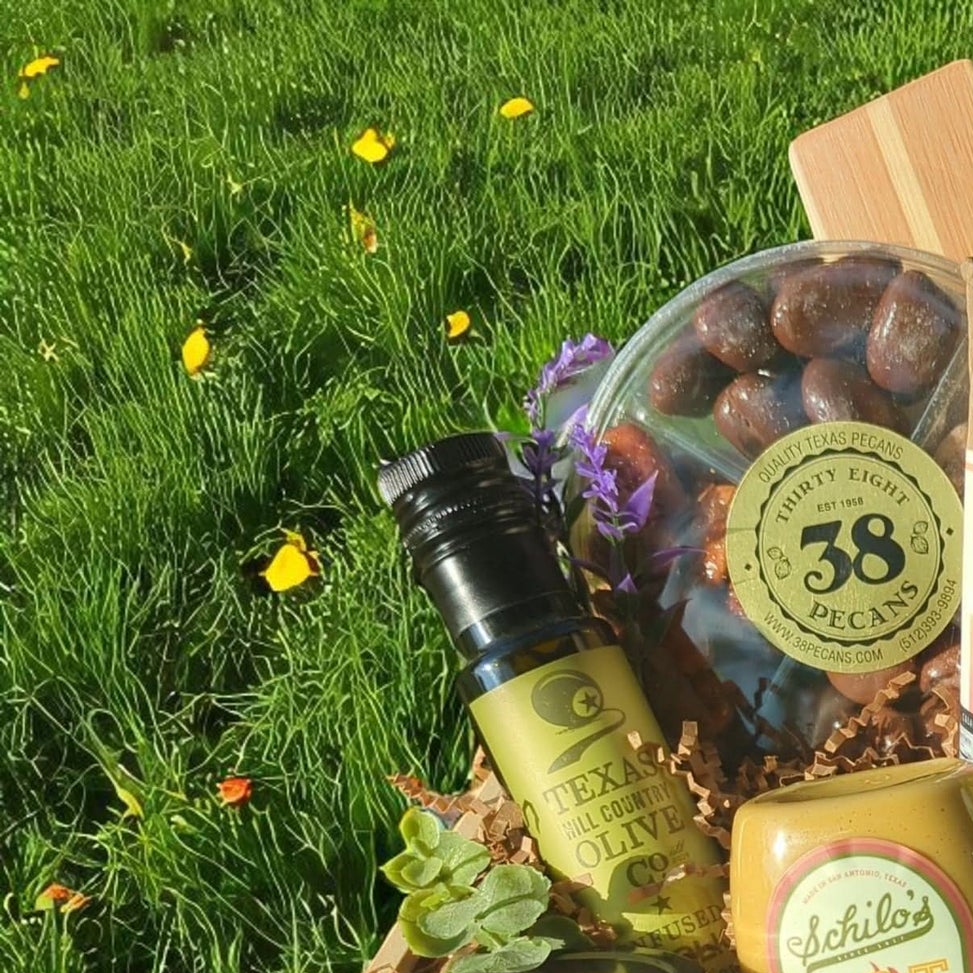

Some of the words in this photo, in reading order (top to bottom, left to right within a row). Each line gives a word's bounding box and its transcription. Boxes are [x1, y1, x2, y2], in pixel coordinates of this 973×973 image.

[758, 443, 801, 483] QUALITY
[805, 431, 847, 452] TEXAS
[851, 432, 904, 460] PECANS
[775, 468, 837, 525] THIRTY
[848, 467, 910, 506] EIGHT
[817, 501, 837, 513] EST
[800, 513, 906, 595] 38
[763, 612, 884, 664] WWW.38PECANS.COM
[899, 579, 958, 653] (512)393-9894
[809, 580, 919, 630] PECANS
[543, 749, 659, 816] TEXAS
[561, 812, 599, 841] HILL
[600, 781, 671, 824] COUNTRY
[575, 806, 686, 870] OLIVE
[787, 889, 935, 967] Schilo's
